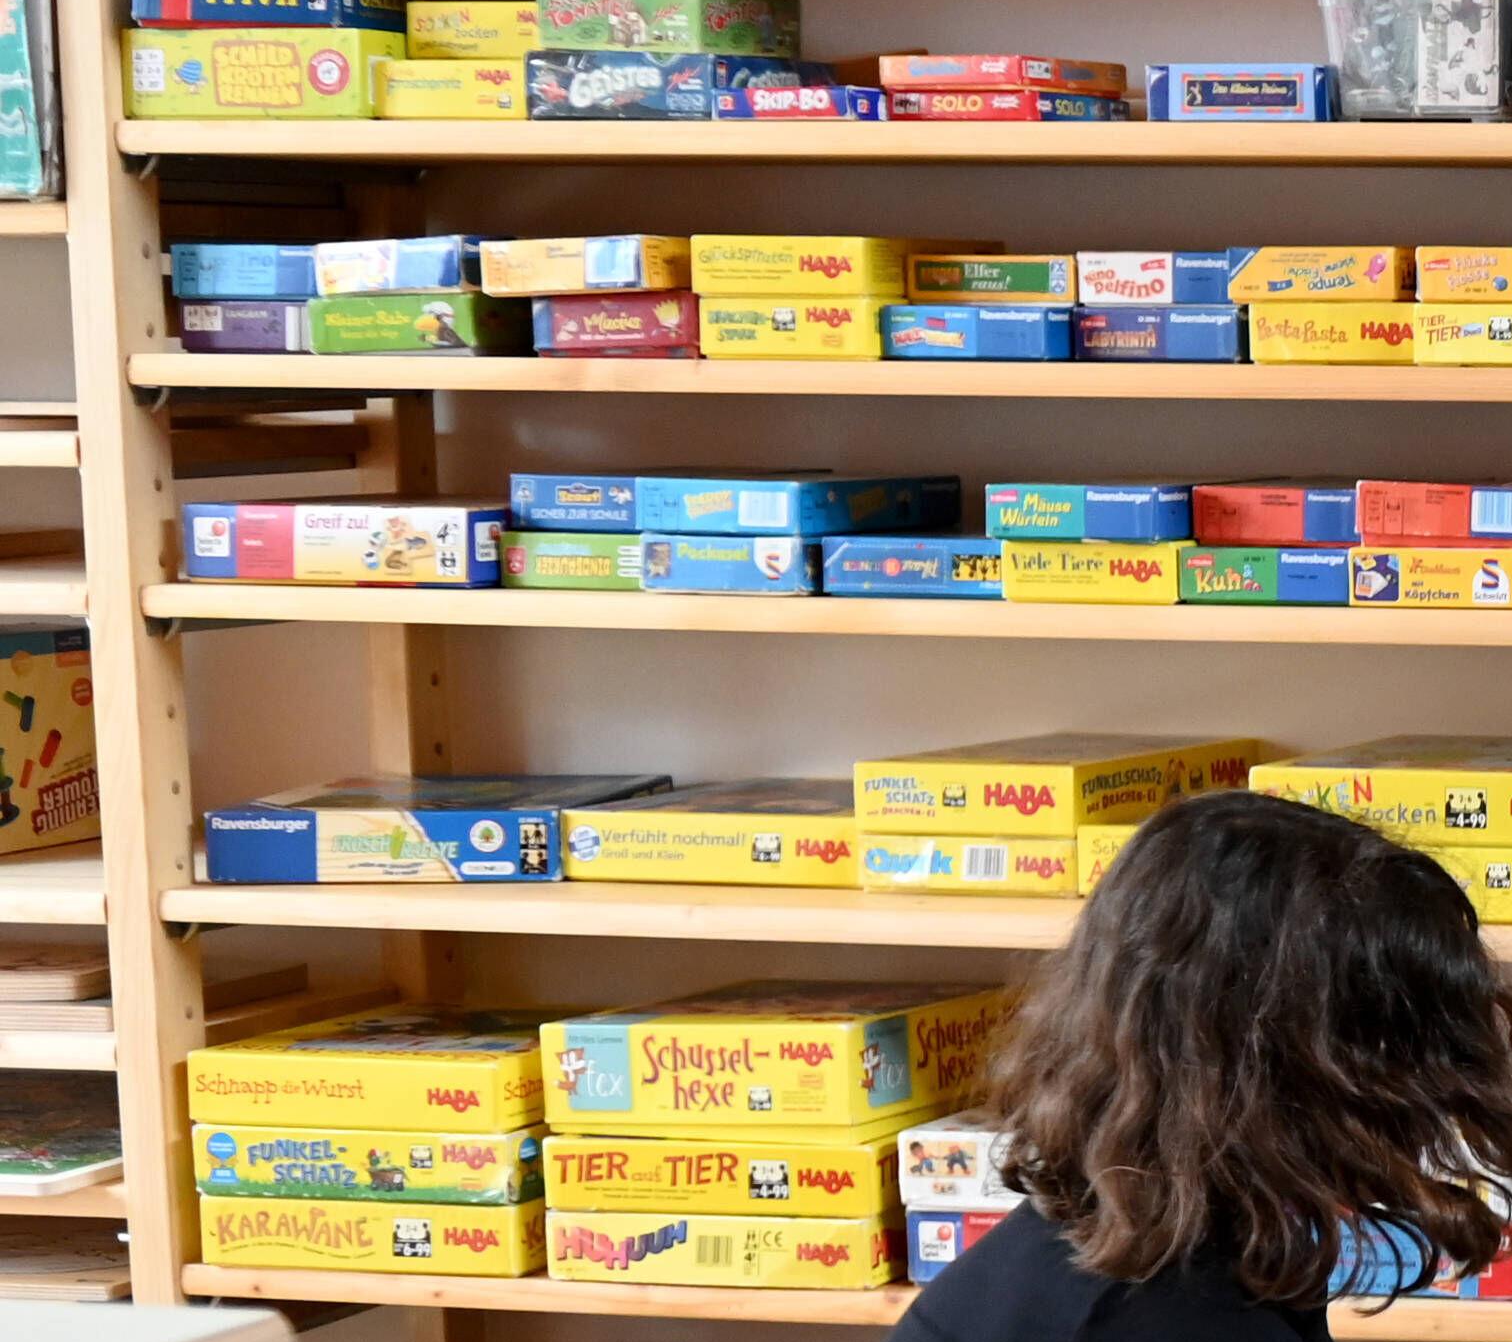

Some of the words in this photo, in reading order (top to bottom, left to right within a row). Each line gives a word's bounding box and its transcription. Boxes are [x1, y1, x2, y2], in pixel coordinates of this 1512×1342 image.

[932, 95, 982, 112] SOLO
[196, 1074, 277, 1104] Schnapp
[301, 1080, 365, 1099] Wurst
[428, 1089, 479, 1110] HABA
[674, 1075, 734, 1111] hexe
[554, 1153, 628, 1184] TIER
[664, 1153, 738, 1184] TIER
